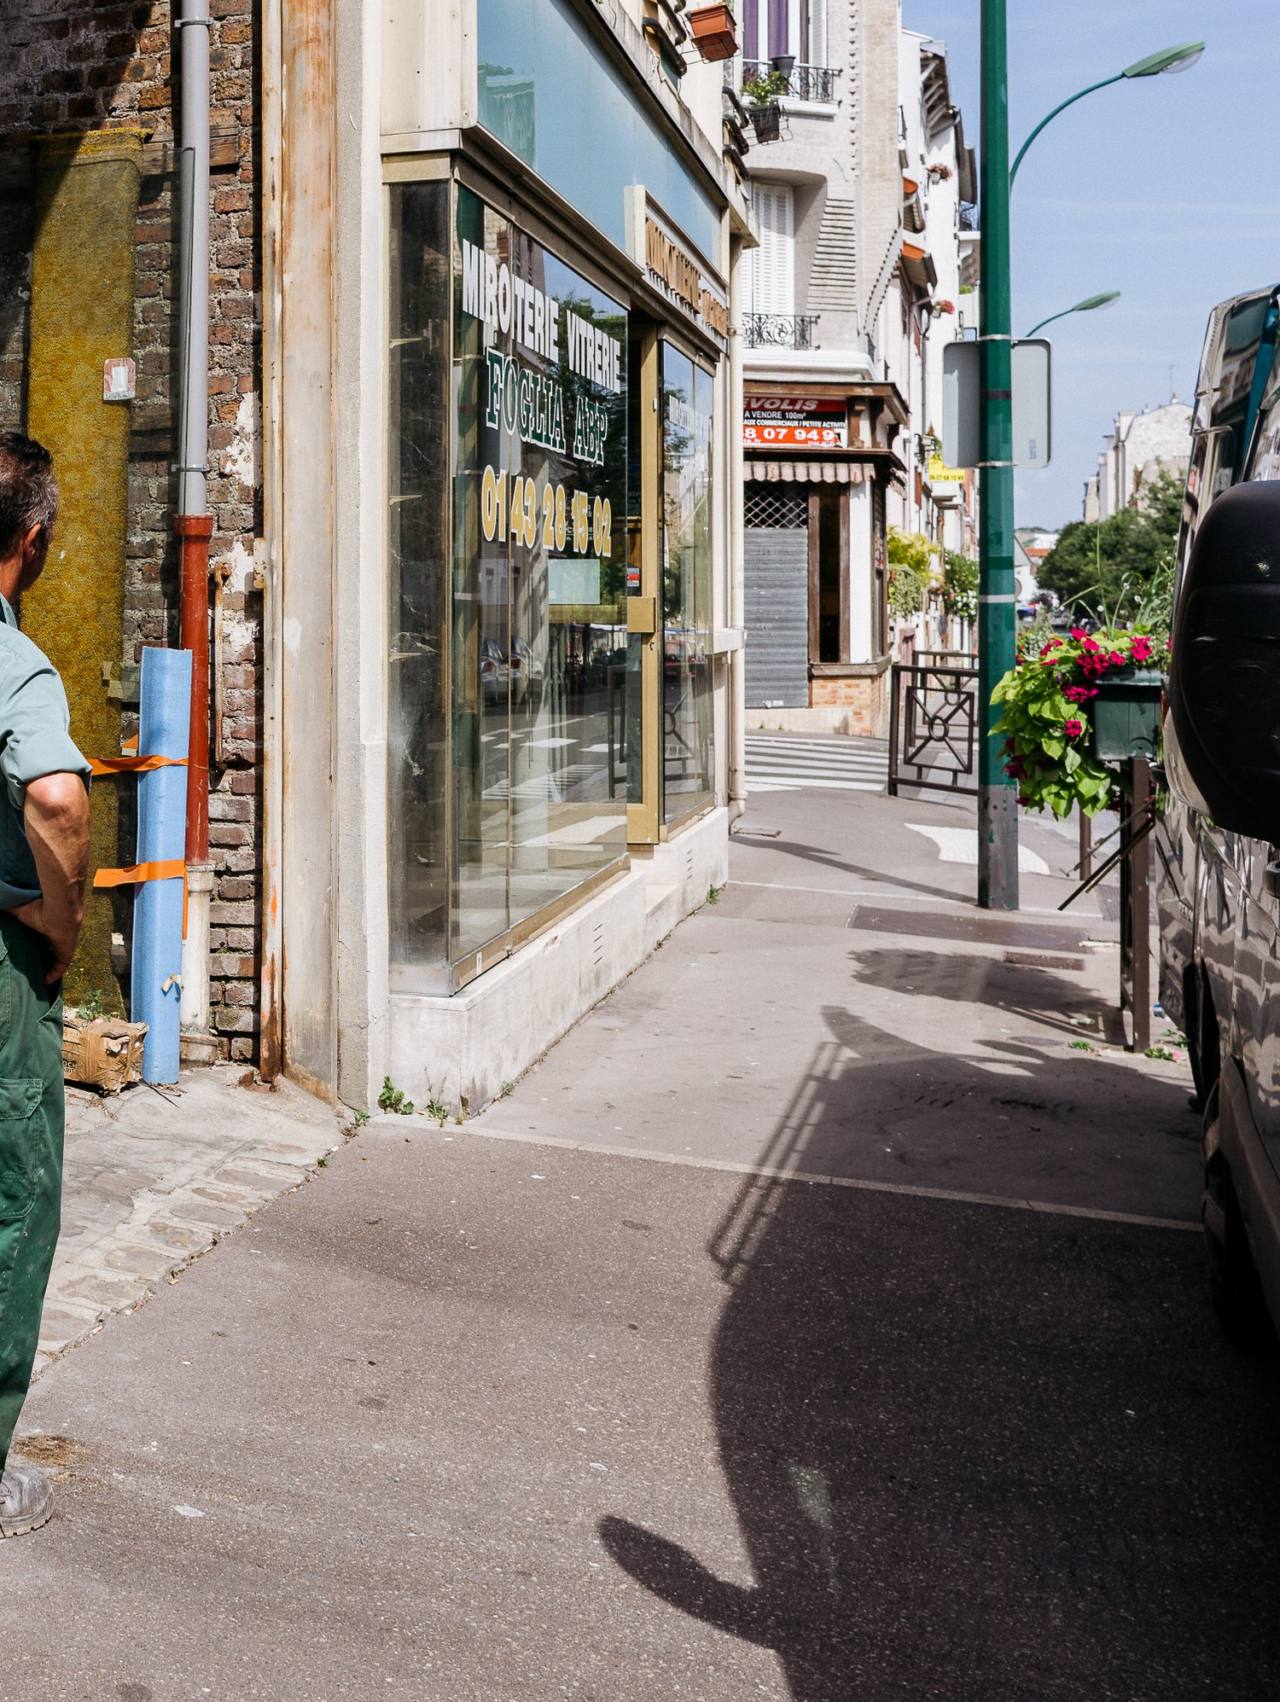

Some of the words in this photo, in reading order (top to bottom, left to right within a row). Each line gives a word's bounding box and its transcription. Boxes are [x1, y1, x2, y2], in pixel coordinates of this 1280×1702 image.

[462, 238, 559, 364] MIROITERIE
[567, 309, 621, 394] VITRERIE
[486, 346, 566, 454] FOGLIA
[573, 395, 608, 466] ABP
[752, 411, 782, 419] VENDRE
[763, 427, 788, 439] 07
[794, 428, 819, 440] 94
[481, 464, 506, 542] 01
[511, 476, 536, 549] 43
[542, 483, 566, 552] 28
[571, 489, 589, 554] 15
[593, 495, 612, 557] 02
